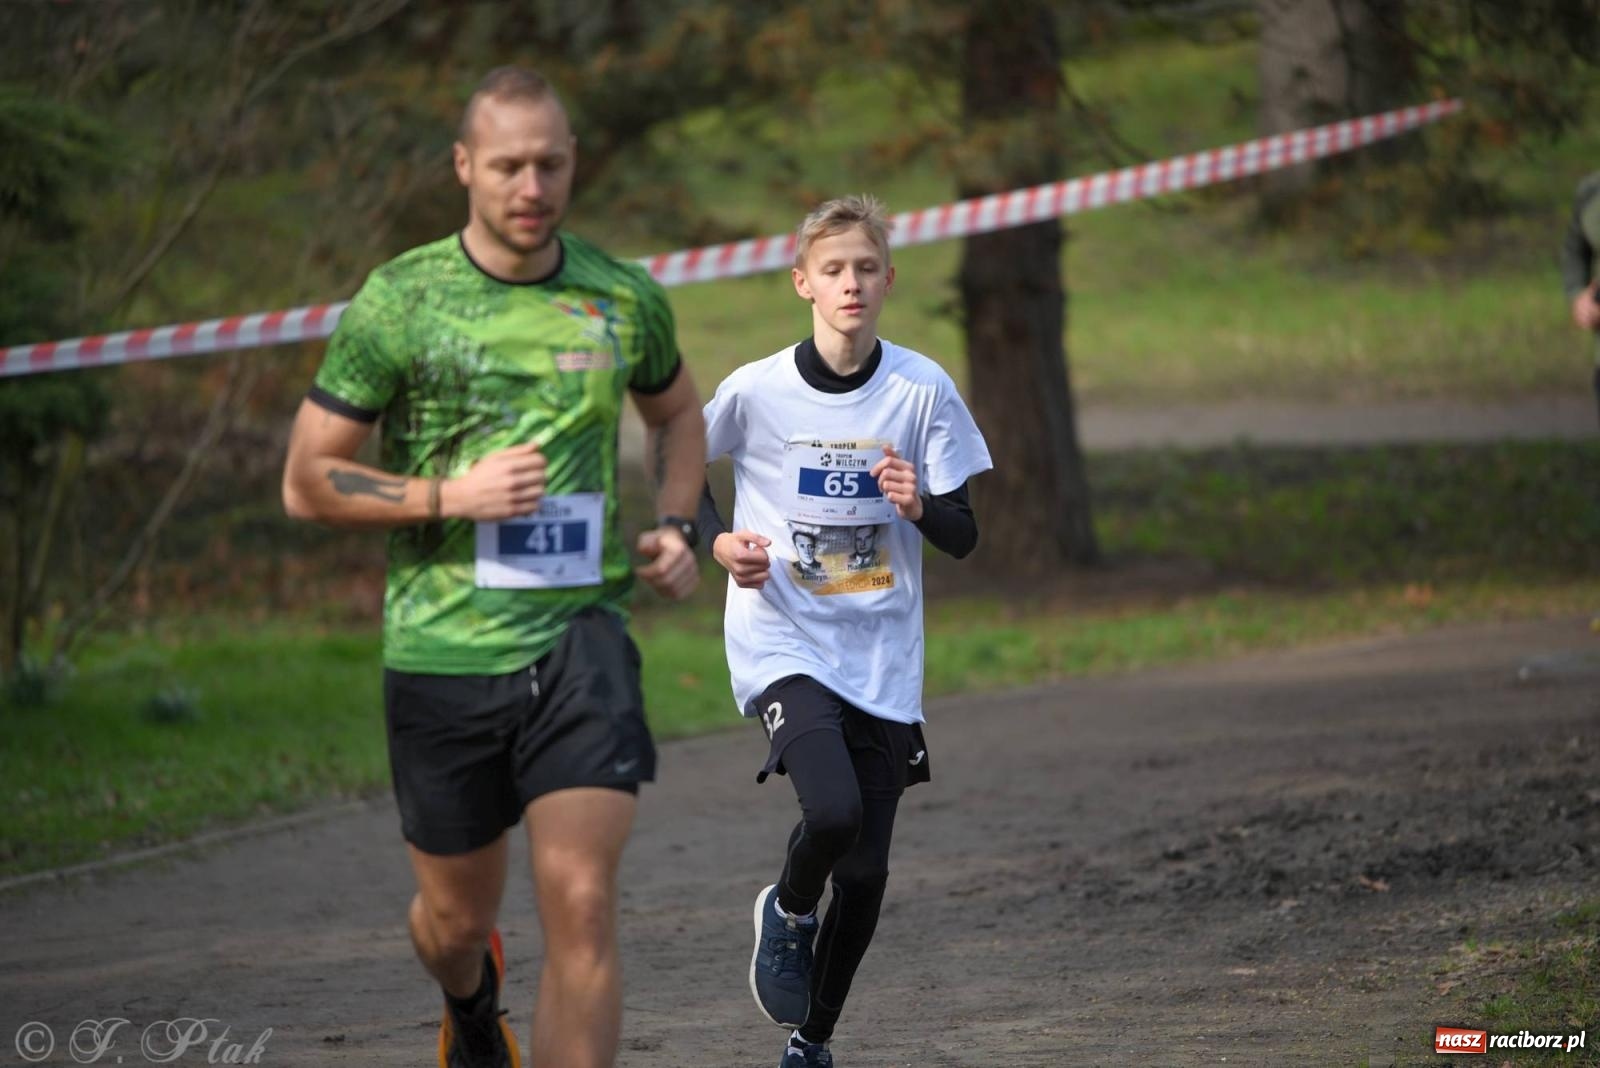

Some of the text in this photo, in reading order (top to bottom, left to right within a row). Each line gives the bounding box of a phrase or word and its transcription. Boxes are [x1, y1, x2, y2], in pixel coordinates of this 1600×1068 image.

[836, 459, 867, 467] WILCZYM
[823, 472, 860, 497] 65
[525, 523, 564, 553] 41
[871, 575, 890, 586] 2024
